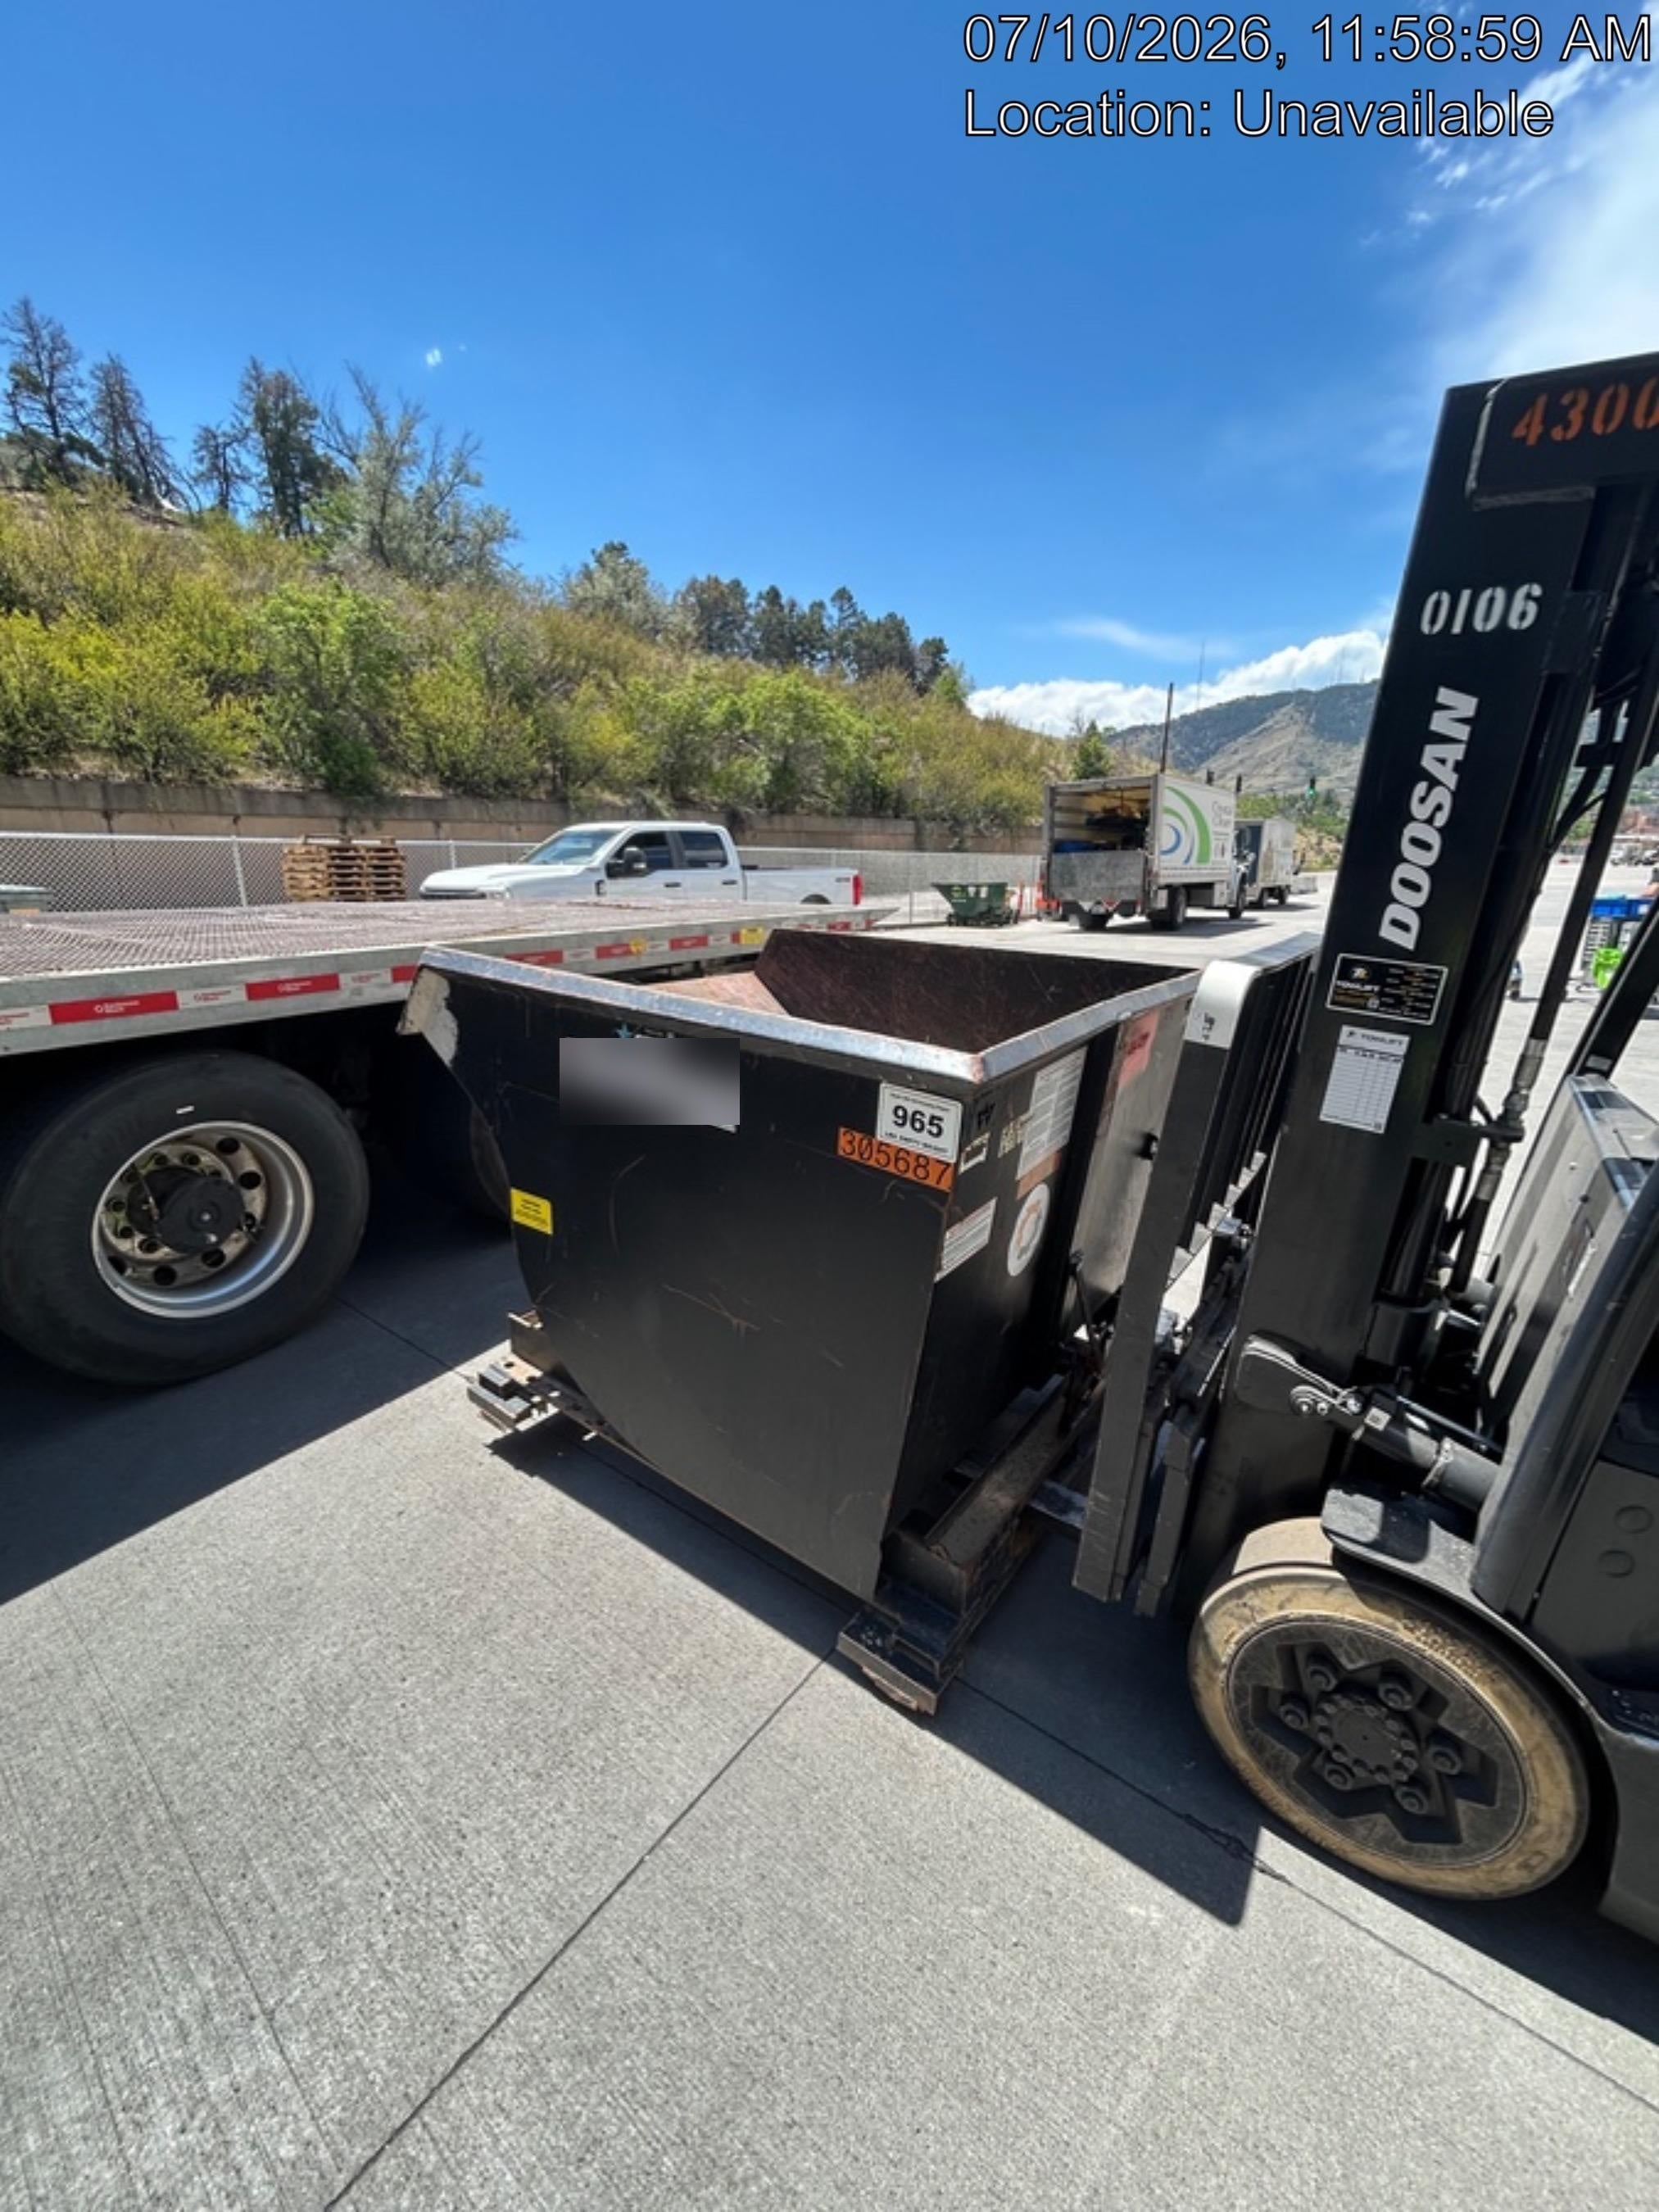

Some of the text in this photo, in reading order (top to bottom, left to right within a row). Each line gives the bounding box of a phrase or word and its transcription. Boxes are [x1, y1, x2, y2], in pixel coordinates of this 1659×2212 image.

[1420, 582, 1543, 636] 0106
[1378, 686, 1480, 952] DOOSAN
[892, 1104, 945, 1138] 965
[841, 1129, 953, 1185] 305687
